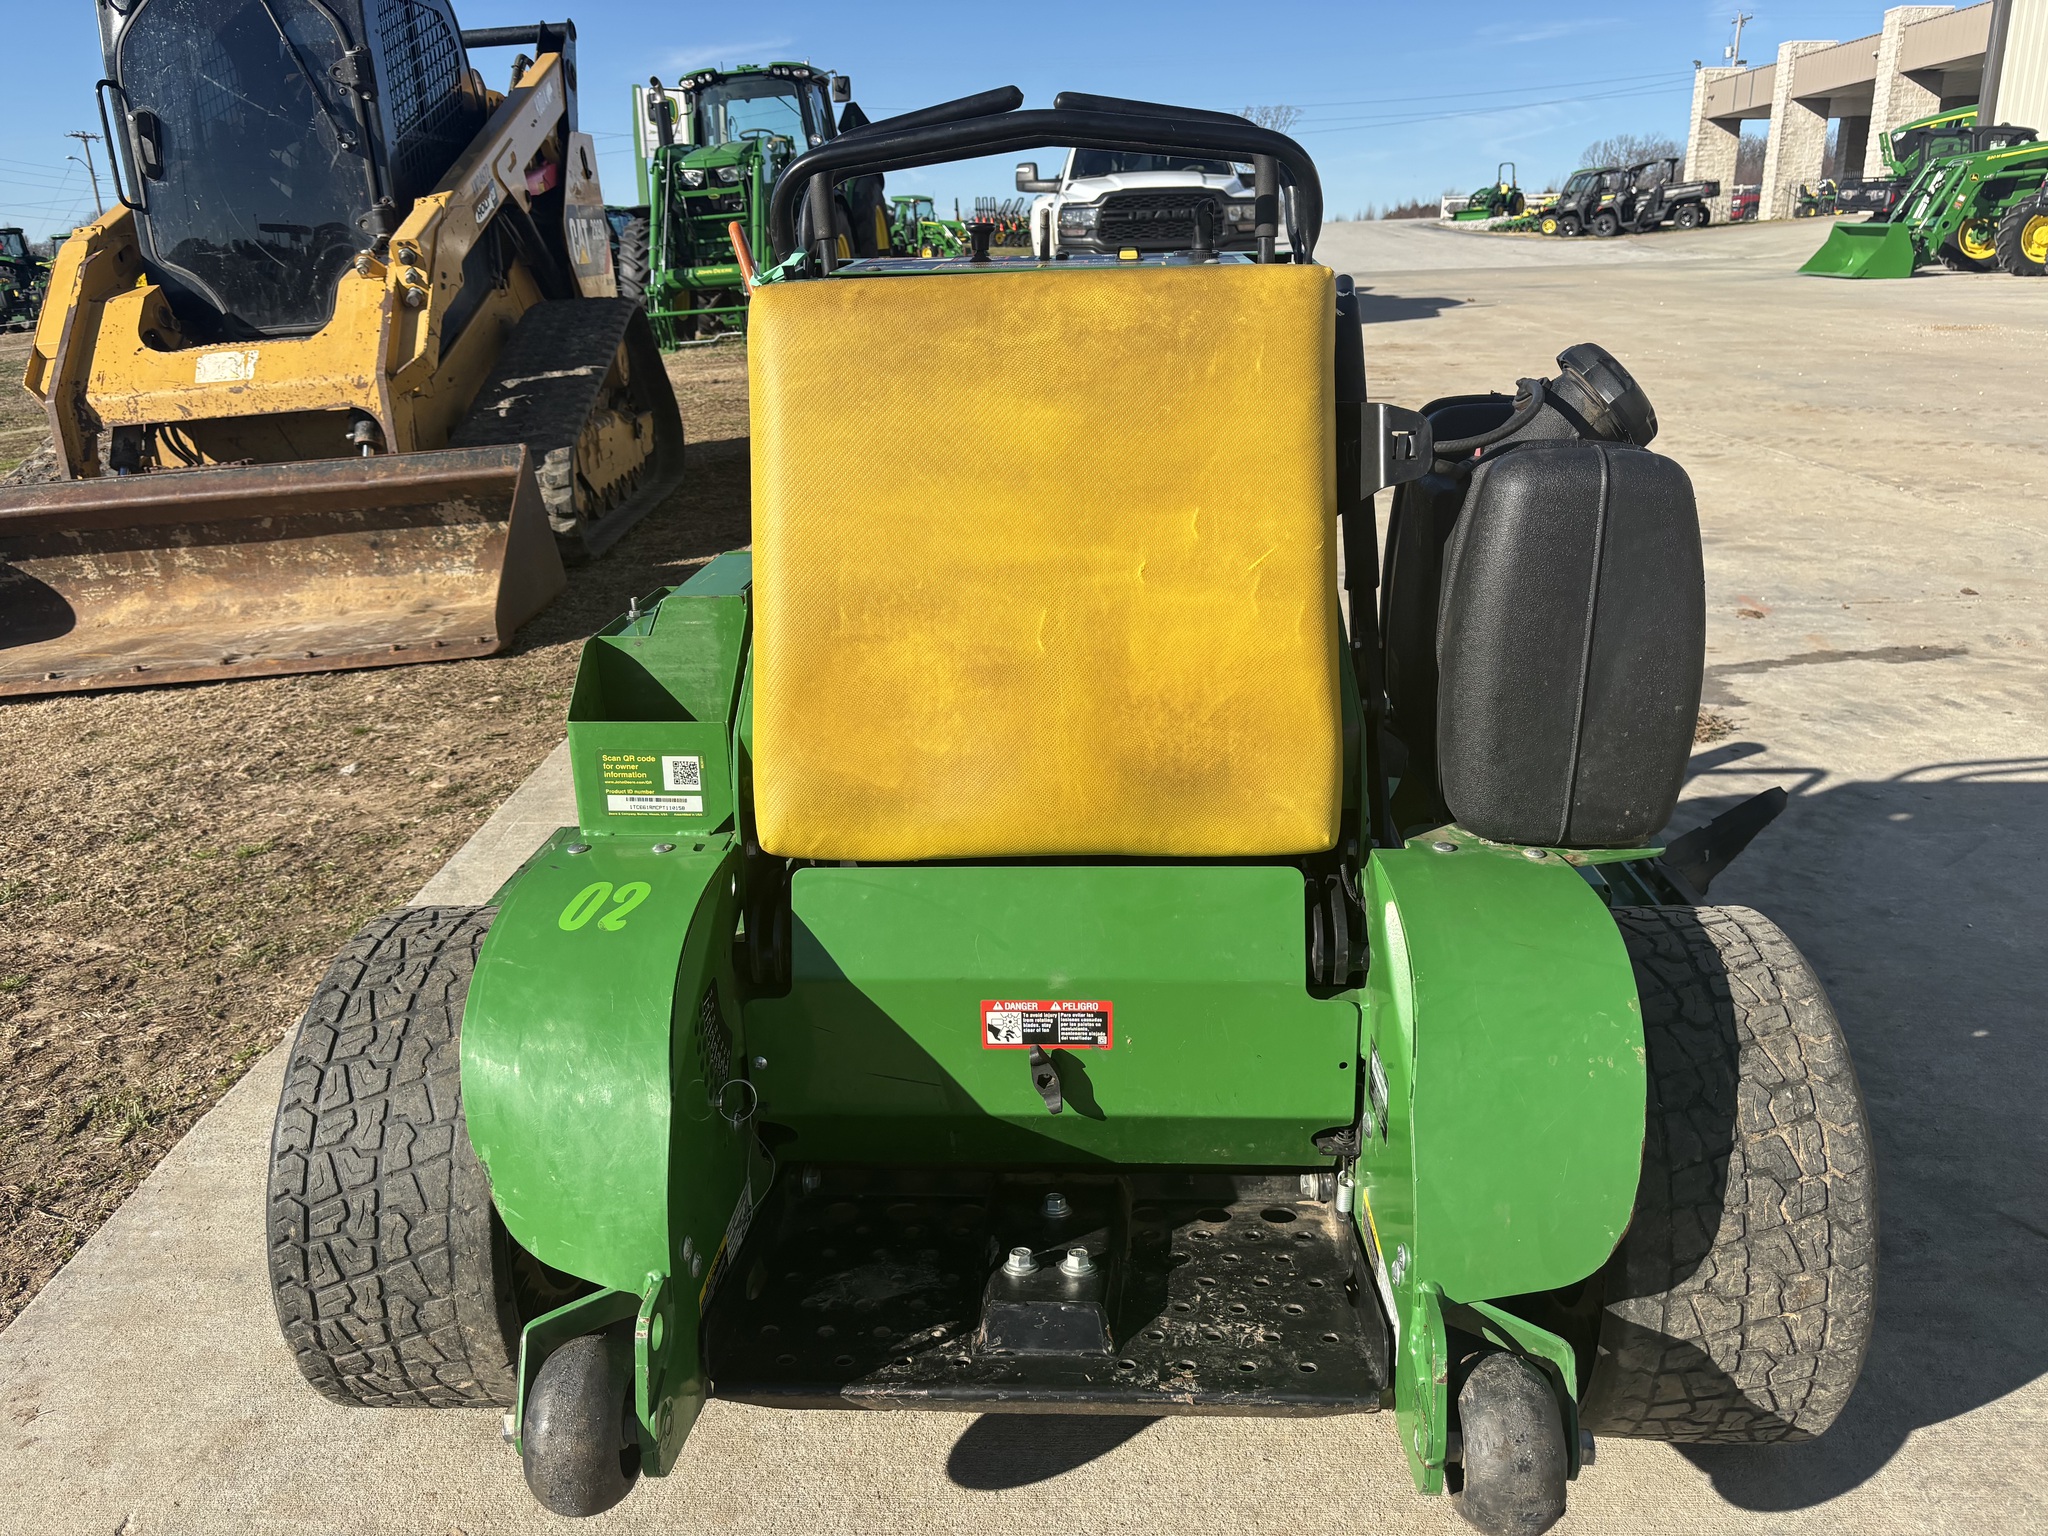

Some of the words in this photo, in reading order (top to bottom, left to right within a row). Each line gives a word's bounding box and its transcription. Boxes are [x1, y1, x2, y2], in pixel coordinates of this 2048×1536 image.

[568, 218, 592, 264] CAT
[602, 754, 622, 762] Scan
[622, 754, 635, 762] QR
[558, 881, 652, 931] 02
[1004, 1002, 1038, 1010] DANGER
[1062, 1002, 1099, 1010] PELIGRO
